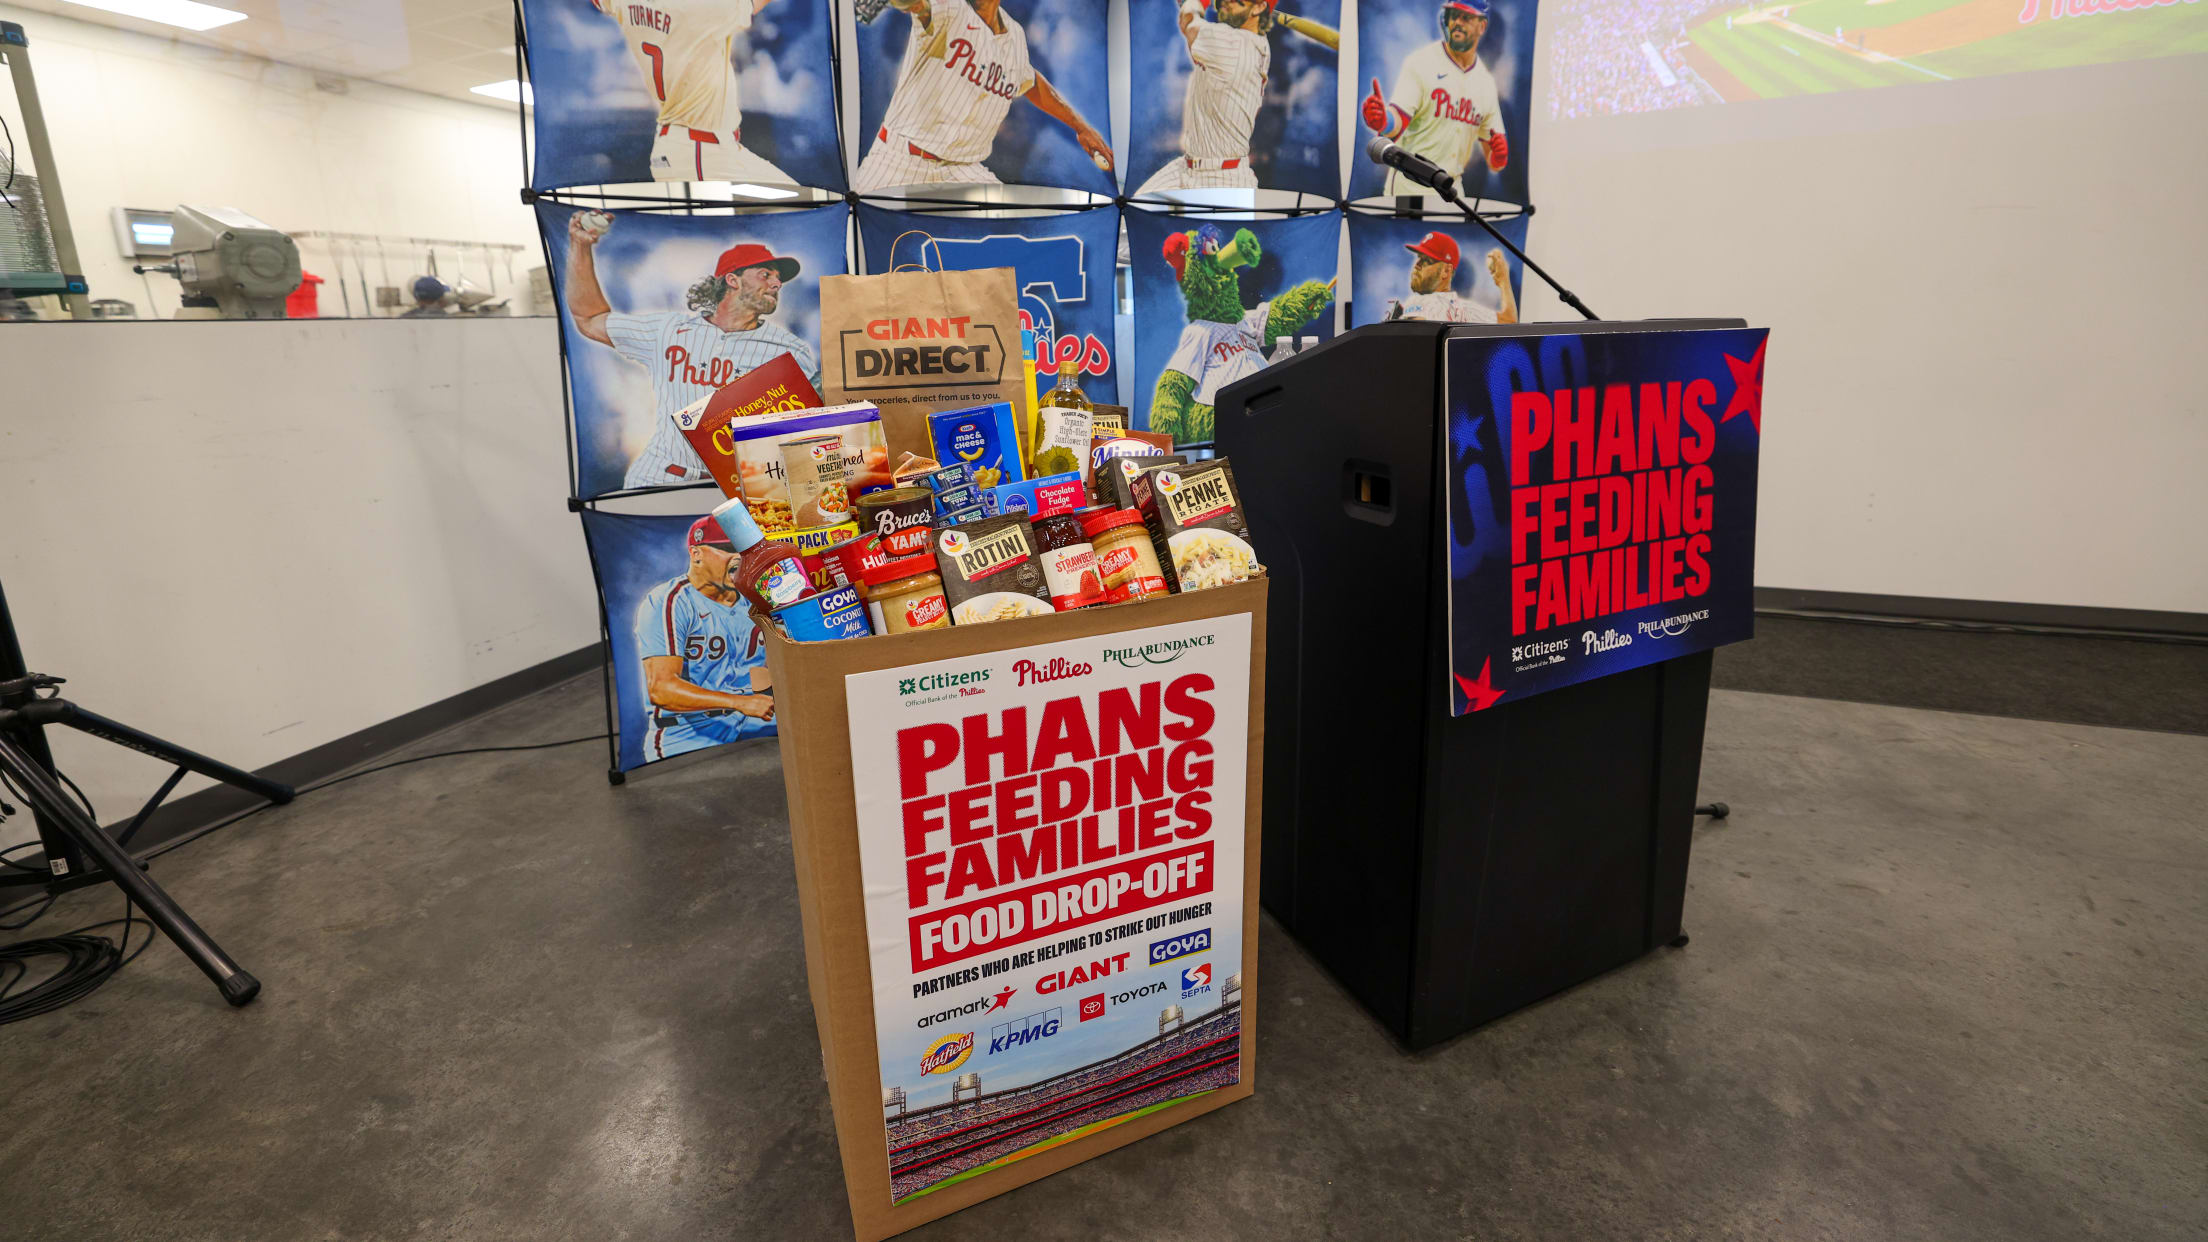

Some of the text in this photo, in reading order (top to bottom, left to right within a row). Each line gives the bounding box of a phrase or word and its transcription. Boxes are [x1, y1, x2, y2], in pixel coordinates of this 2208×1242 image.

[628, 5, 671, 34] TURNER
[641, 42, 666, 102] 7
[866, 316, 970, 340] GIANT
[734, 395, 767, 417] Honey
[767, 384, 789, 402] Nut
[912, 394, 937, 403] direct
[938, 393, 958, 401] from
[956, 433, 974, 442] mac
[1511, 378, 1717, 486] PHANS
[951, 496, 968, 504] TUNA
[1040, 486, 1075, 499] Chocolate
[1048, 495, 1070, 505] Fudge
[1173, 476, 1227, 511] PENNE
[1179, 496, 1229, 517] RIGATE
[874, 508, 932, 537] Bruce's
[1511, 464, 1714, 566] FEEDING
[797, 531, 829, 550] PACK
[961, 534, 1025, 573] ROTINI
[1101, 549, 1133, 571] CREAMY
[822, 588, 858, 611] GOYA
[1511, 534, 1713, 637] FAMILIES
[912, 596, 942, 620] CREAMY
[841, 621, 862, 637] Milk
[1524, 609, 1710, 658] Citizens Phillies PHILABUNDANCE
[684, 635, 726, 661] 59
[918, 634, 1215, 691] Citizens Phillies PHILABUNDANCE
[905, 697, 927, 707] Official
[927, 696, 941, 704] Bank
[959, 687, 985, 697] Phillies
[896, 673, 1215, 800] PHANS
[901, 738, 1214, 858] FEEDING
[905, 791, 1213, 910] FAMILIES
[919, 851, 1205, 961] FOOD DROP-OFF
[913, 902, 1212, 998] PARTNERS WHO ARE HELPING TO STRIKE OUT HUNGER
[1152, 932, 1209, 961] GOYA
[1035, 951, 1130, 995] GIANT
[1110, 981, 1168, 1006] TOYOTA
[1181, 985, 1211, 1000] SEPTA
[917, 996, 990, 1029] aramark
[988, 1019, 1060, 1056] KPMG
[920, 1031, 975, 1077] Hatfield
